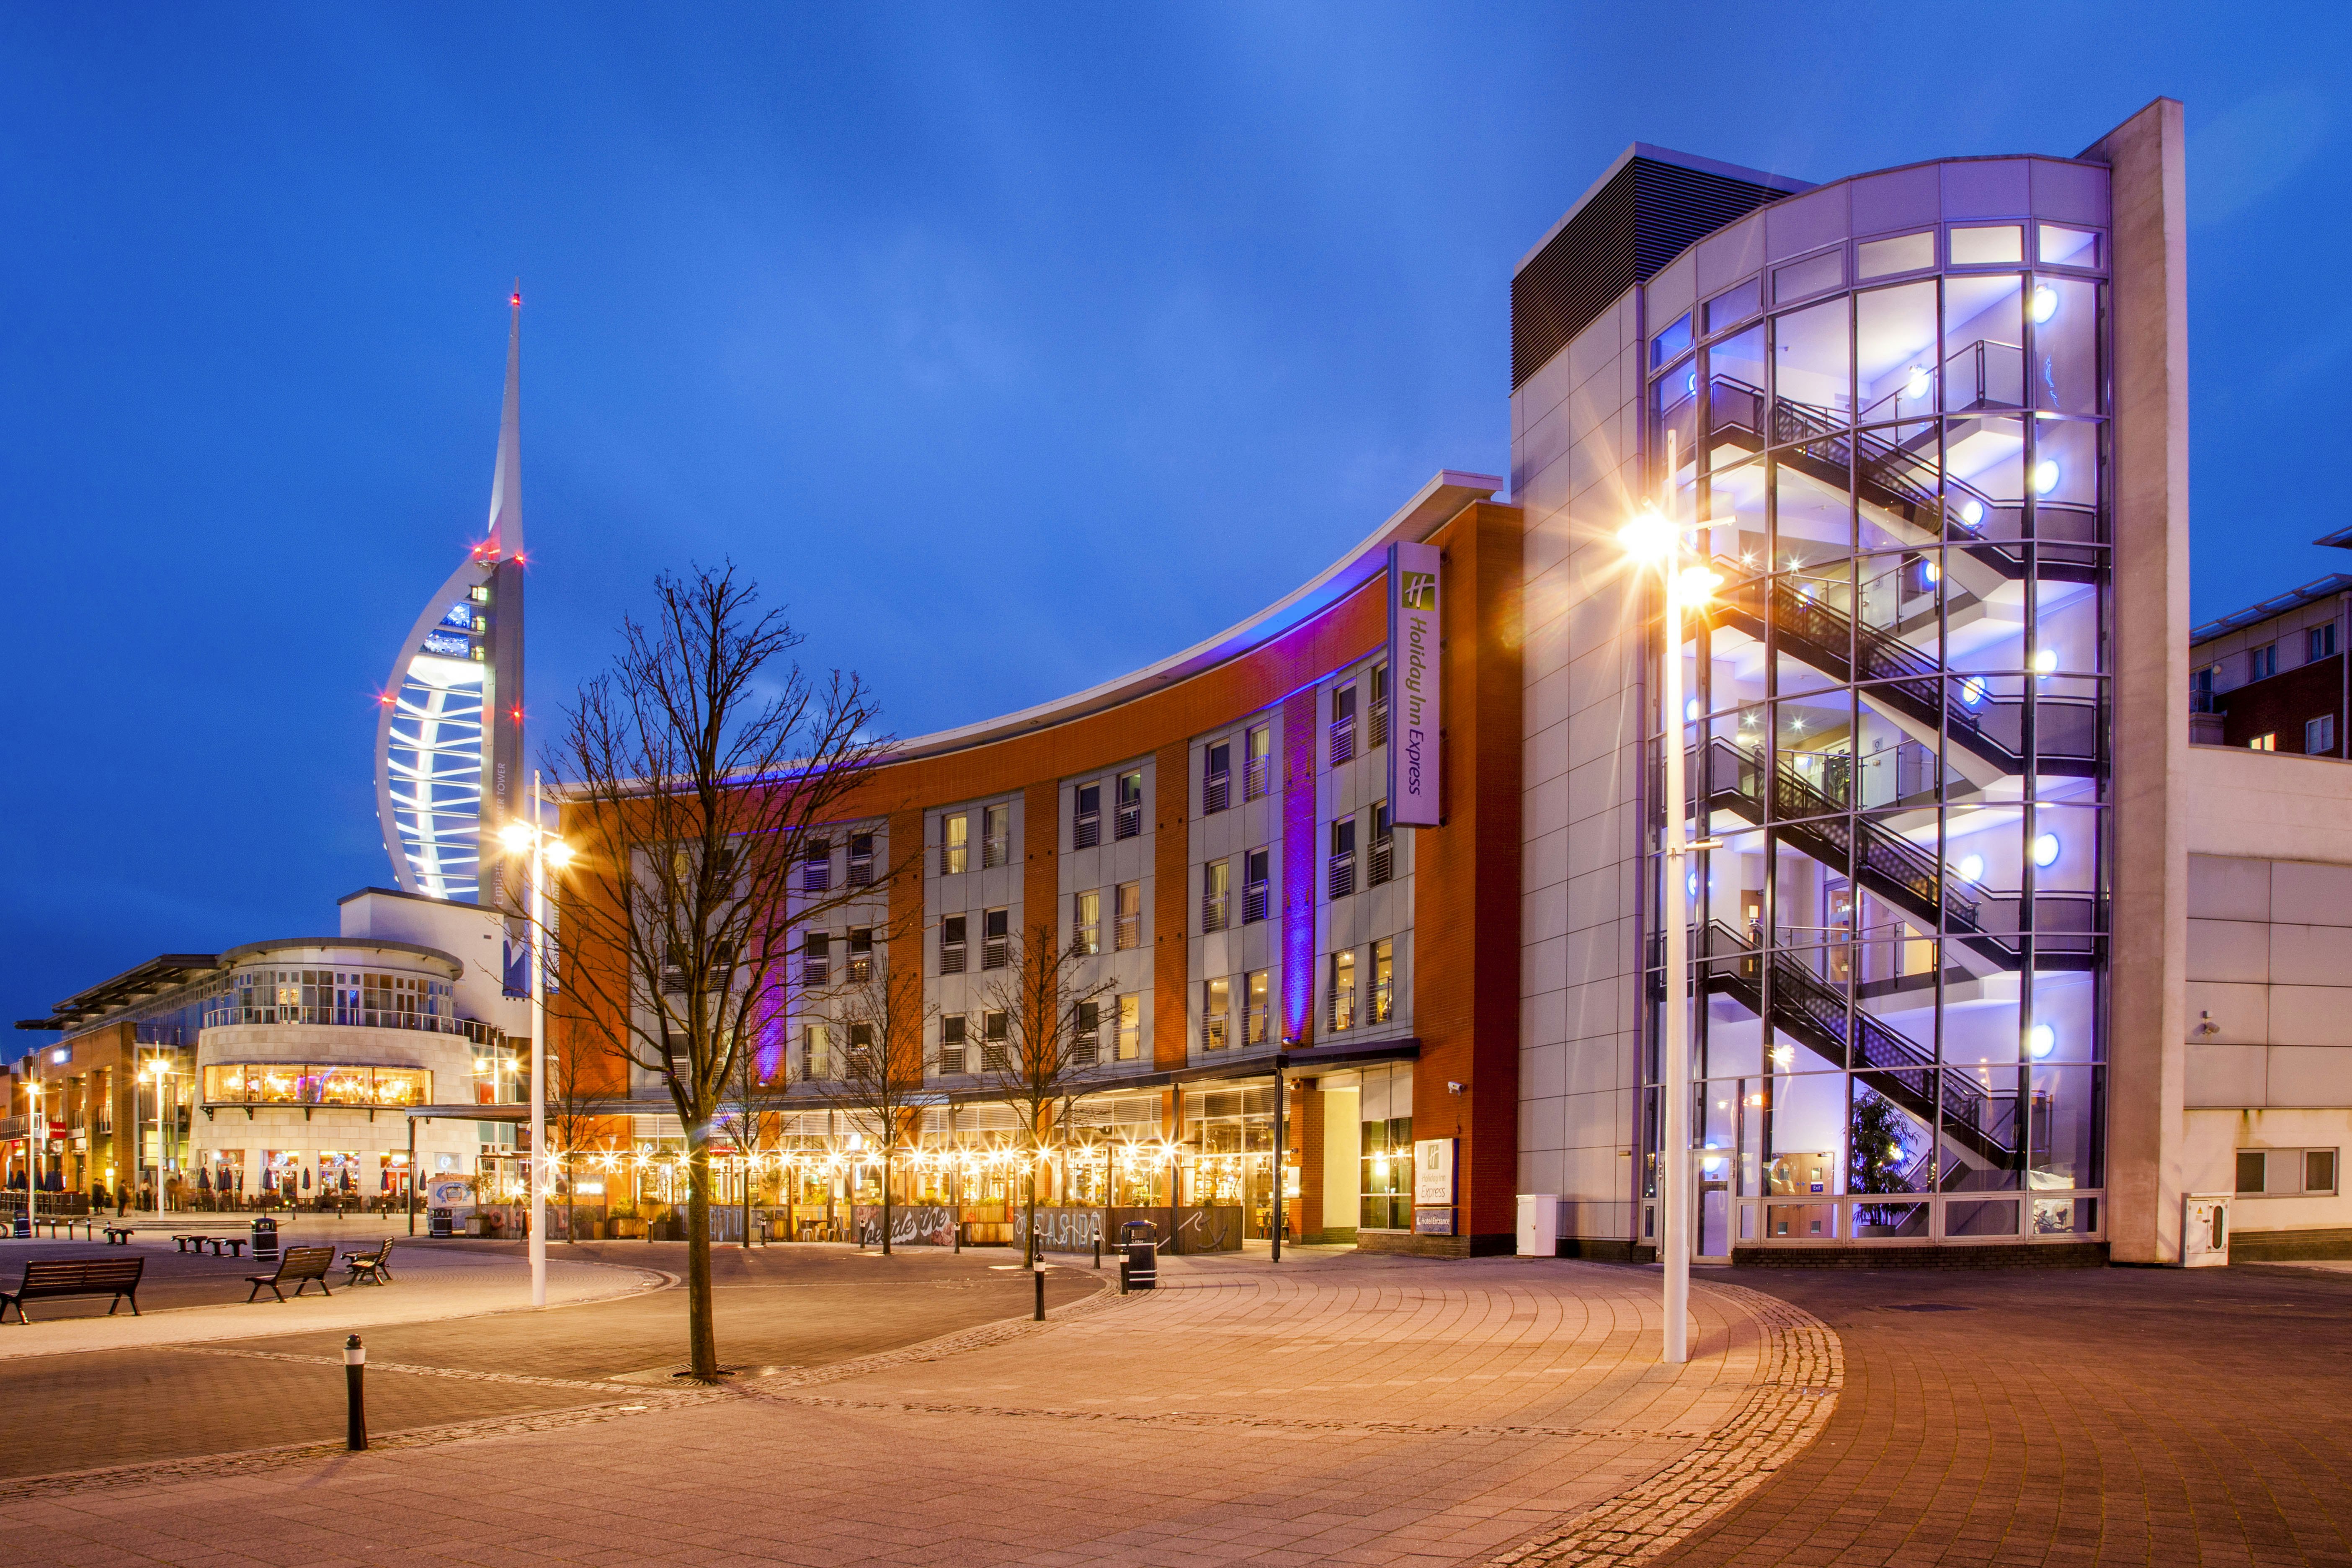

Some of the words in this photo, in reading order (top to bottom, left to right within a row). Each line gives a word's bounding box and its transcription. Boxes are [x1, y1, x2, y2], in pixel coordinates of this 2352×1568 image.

[1406, 616, 1427, 693] Holiday
[1409, 695, 1426, 726] Inn
[1406, 729, 1424, 795] Express
[497, 763, 505, 795] TOWER
[493, 857, 503, 905] Emirate
[1421, 1185, 1445, 1201] Express
[1422, 1173, 1438, 1184] Holiday
[865, 1210, 916, 1242] beide
[1421, 1217, 1432, 1225] Hotel
[1432, 1217, 1450, 1225] Entrance
